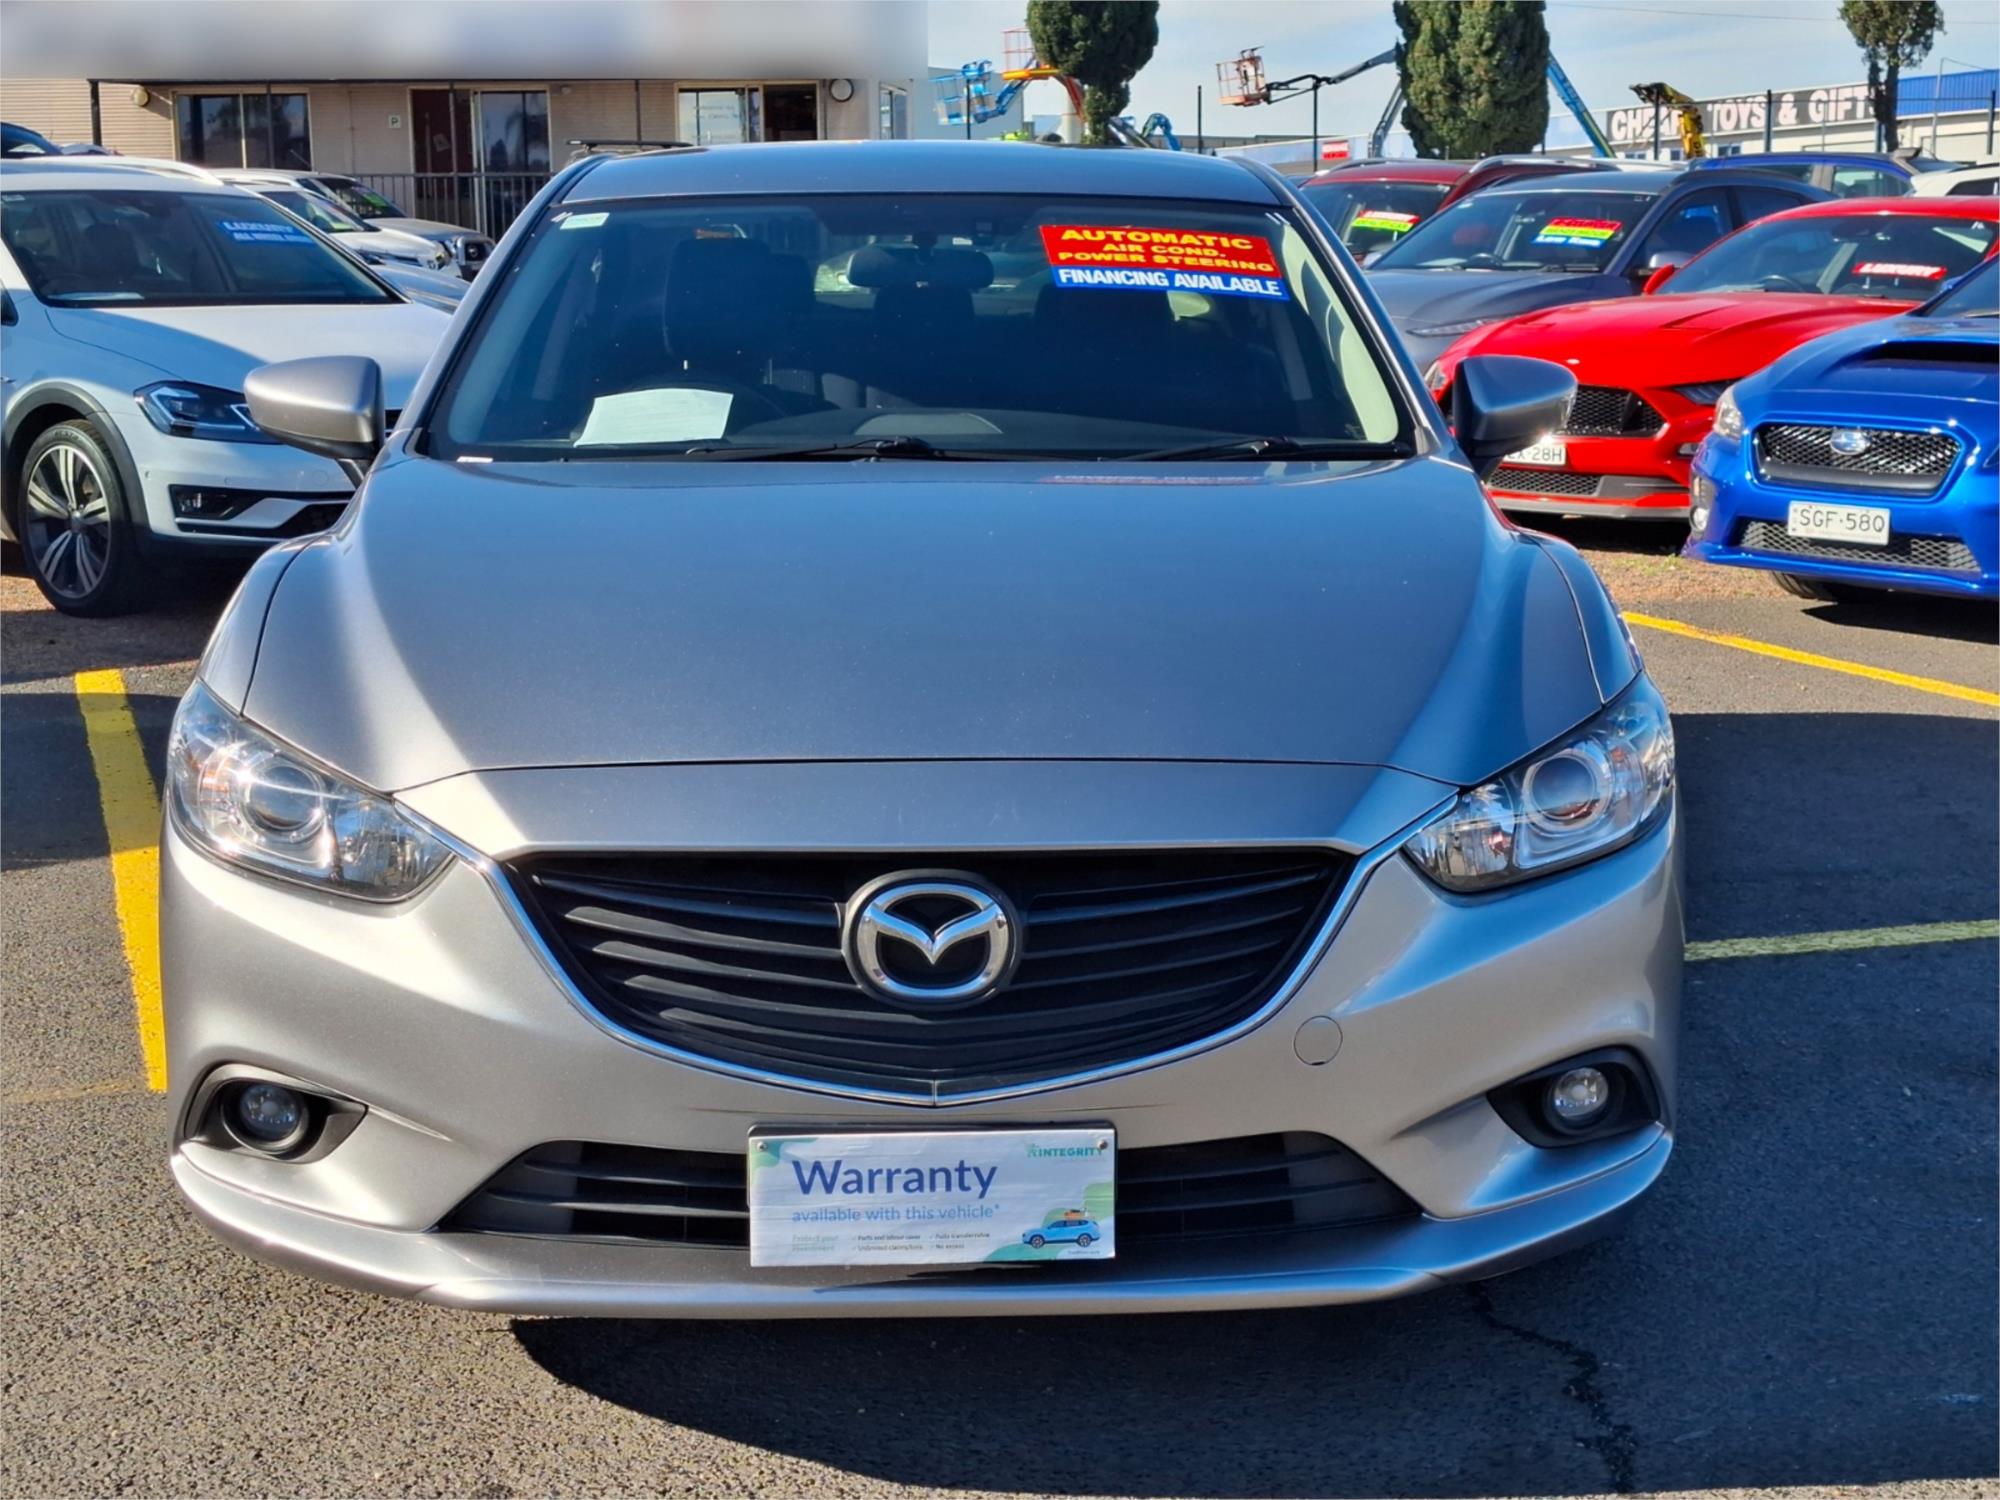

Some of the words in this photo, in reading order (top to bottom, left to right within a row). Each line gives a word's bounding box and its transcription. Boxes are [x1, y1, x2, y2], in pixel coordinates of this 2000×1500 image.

[1707, 95, 1767, 131] TOYS
[1778, 93, 1797, 125] &
[1808, 86, 1875, 122] GIFT
[1061, 229, 1253, 250] AUTOMATIC
[1103, 243, 1145, 253] AIR
[1151, 244, 1227, 258] COND.
[1058, 252, 1146, 263] POWER
[1153, 255, 1274, 273] STEERING
[1058, 268, 1169, 287] FINANCING
[1174, 273, 1283, 296] AVAILABLE
[1039, 1147, 1103, 1158] INTEGRITY
[792, 1159, 998, 1199] Warranty
[792, 1208, 861, 1223] available
[865, 1207, 900, 1221] with
[905, 1206, 934, 1220] this
